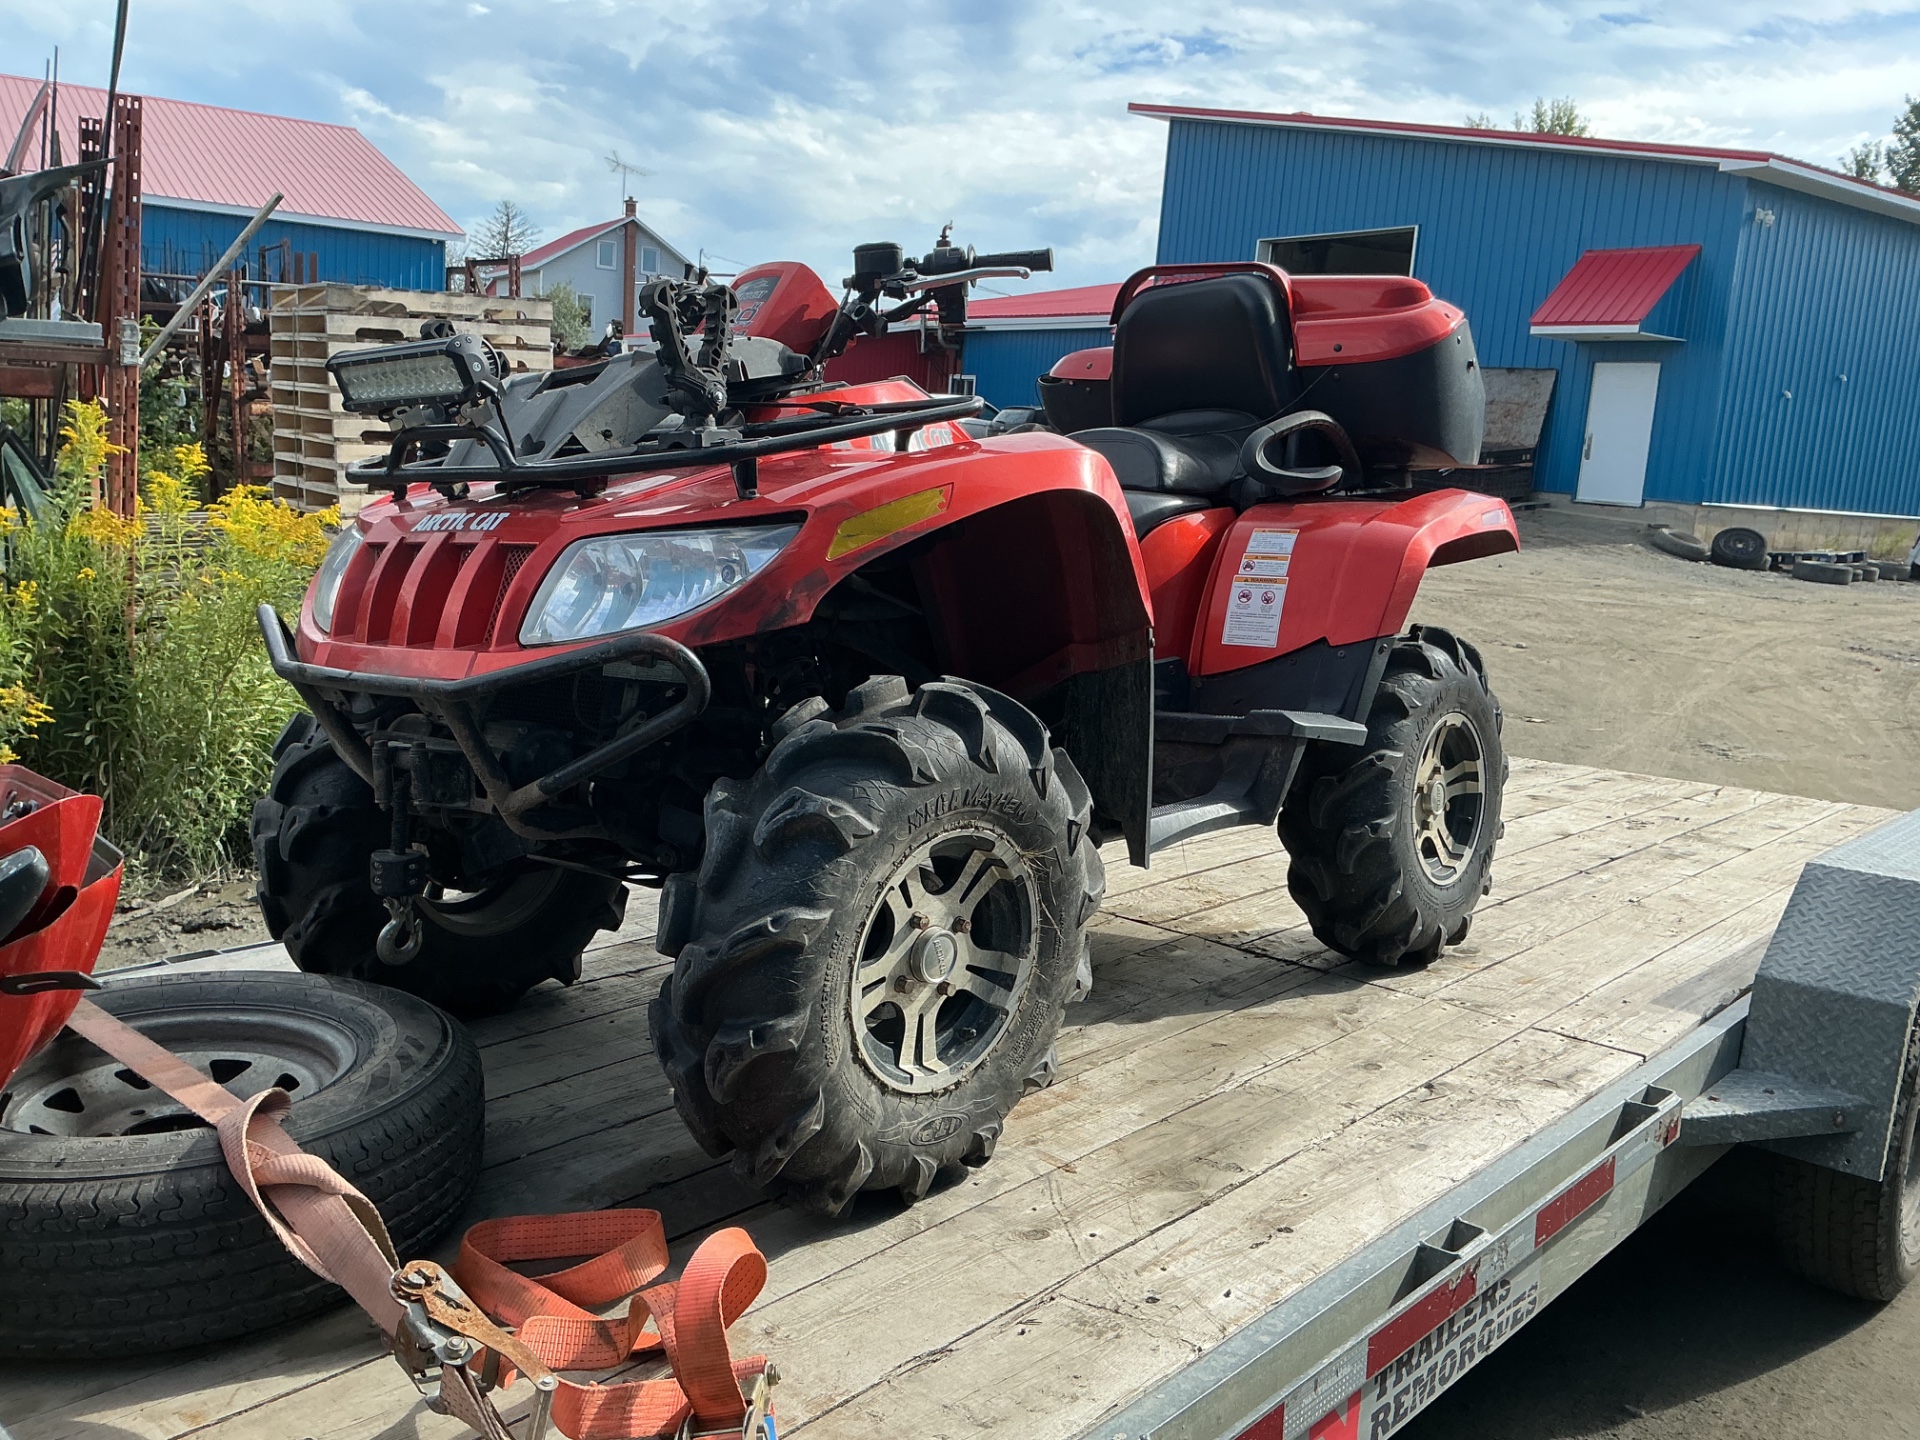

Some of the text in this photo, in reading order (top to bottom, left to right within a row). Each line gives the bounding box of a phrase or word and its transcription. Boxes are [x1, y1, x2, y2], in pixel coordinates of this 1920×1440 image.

[411, 512, 511, 532] ARCTIC CAT
[963, 783, 1031, 820] MAYHEM
[1370, 1282, 1539, 1440] REMORQUES
[1374, 1278, 1512, 1402] TRAILERS
